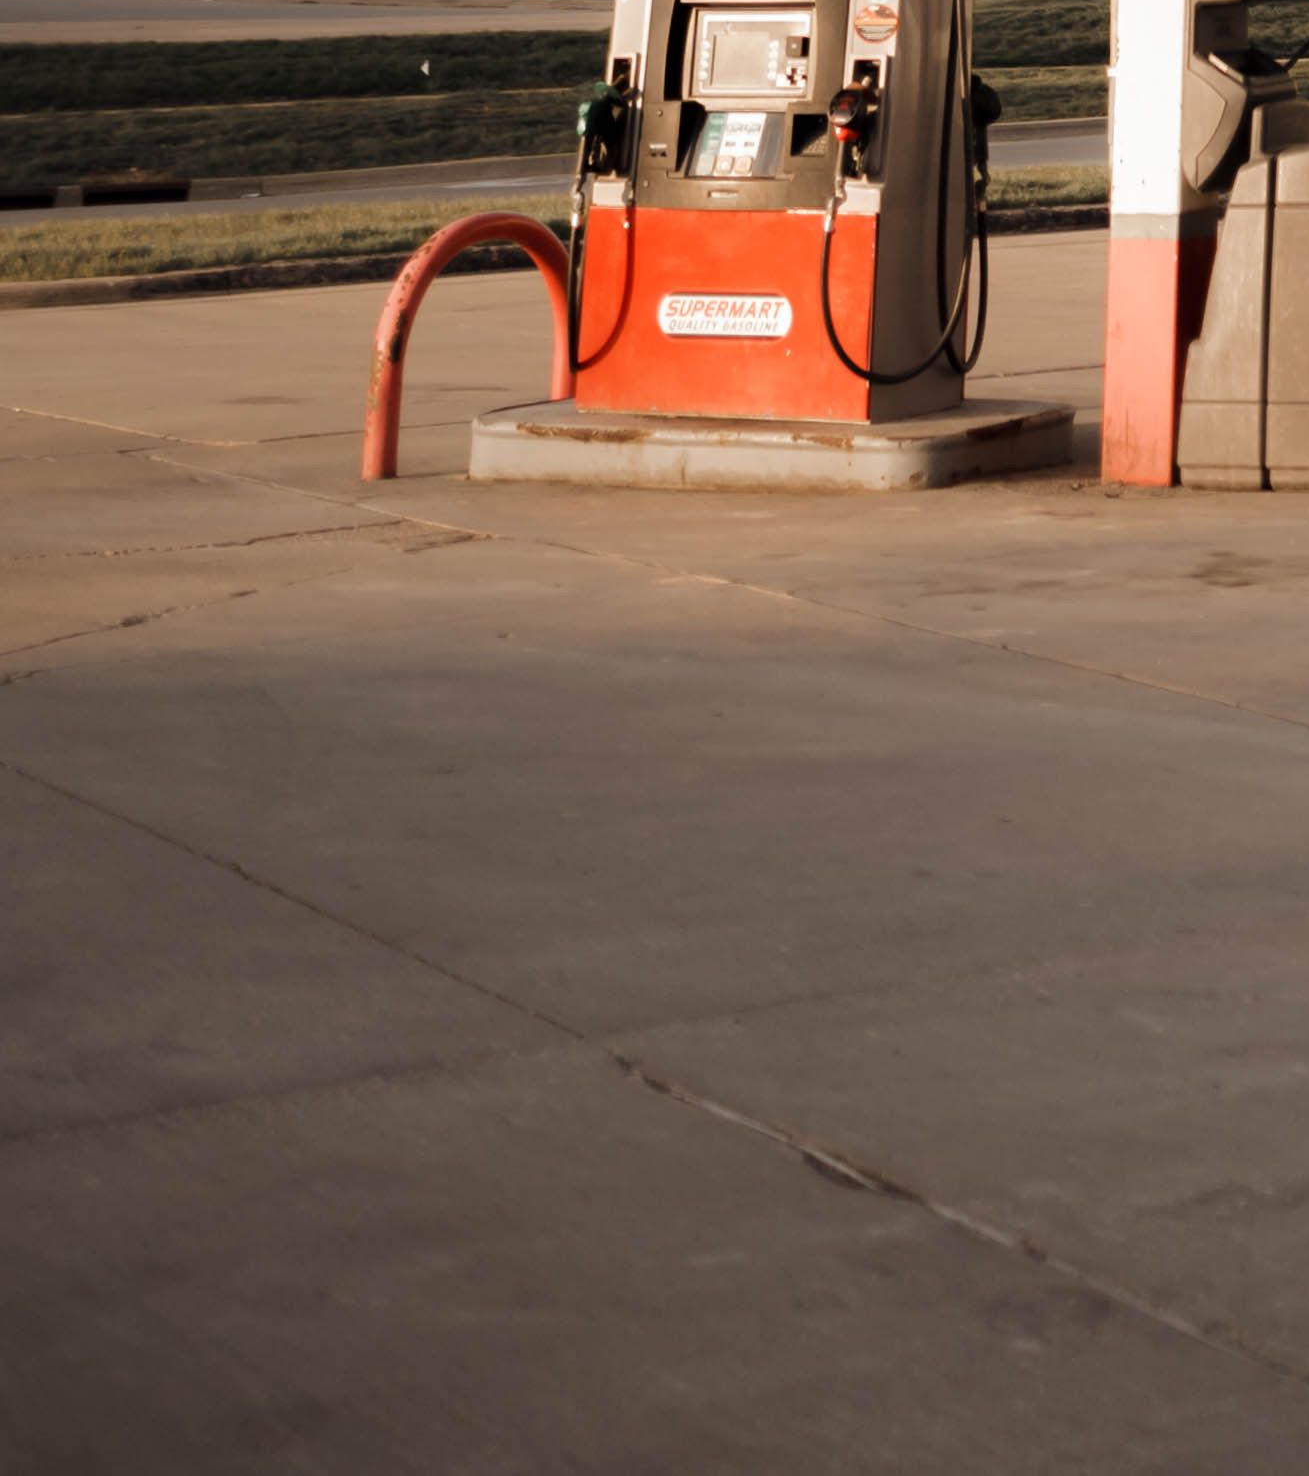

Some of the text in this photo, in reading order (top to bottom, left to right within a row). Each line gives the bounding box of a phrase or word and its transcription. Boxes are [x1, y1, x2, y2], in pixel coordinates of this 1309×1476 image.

[665, 299, 784, 318] SUPERMART
[669, 319, 778, 333] QUALITY GASOLINE
